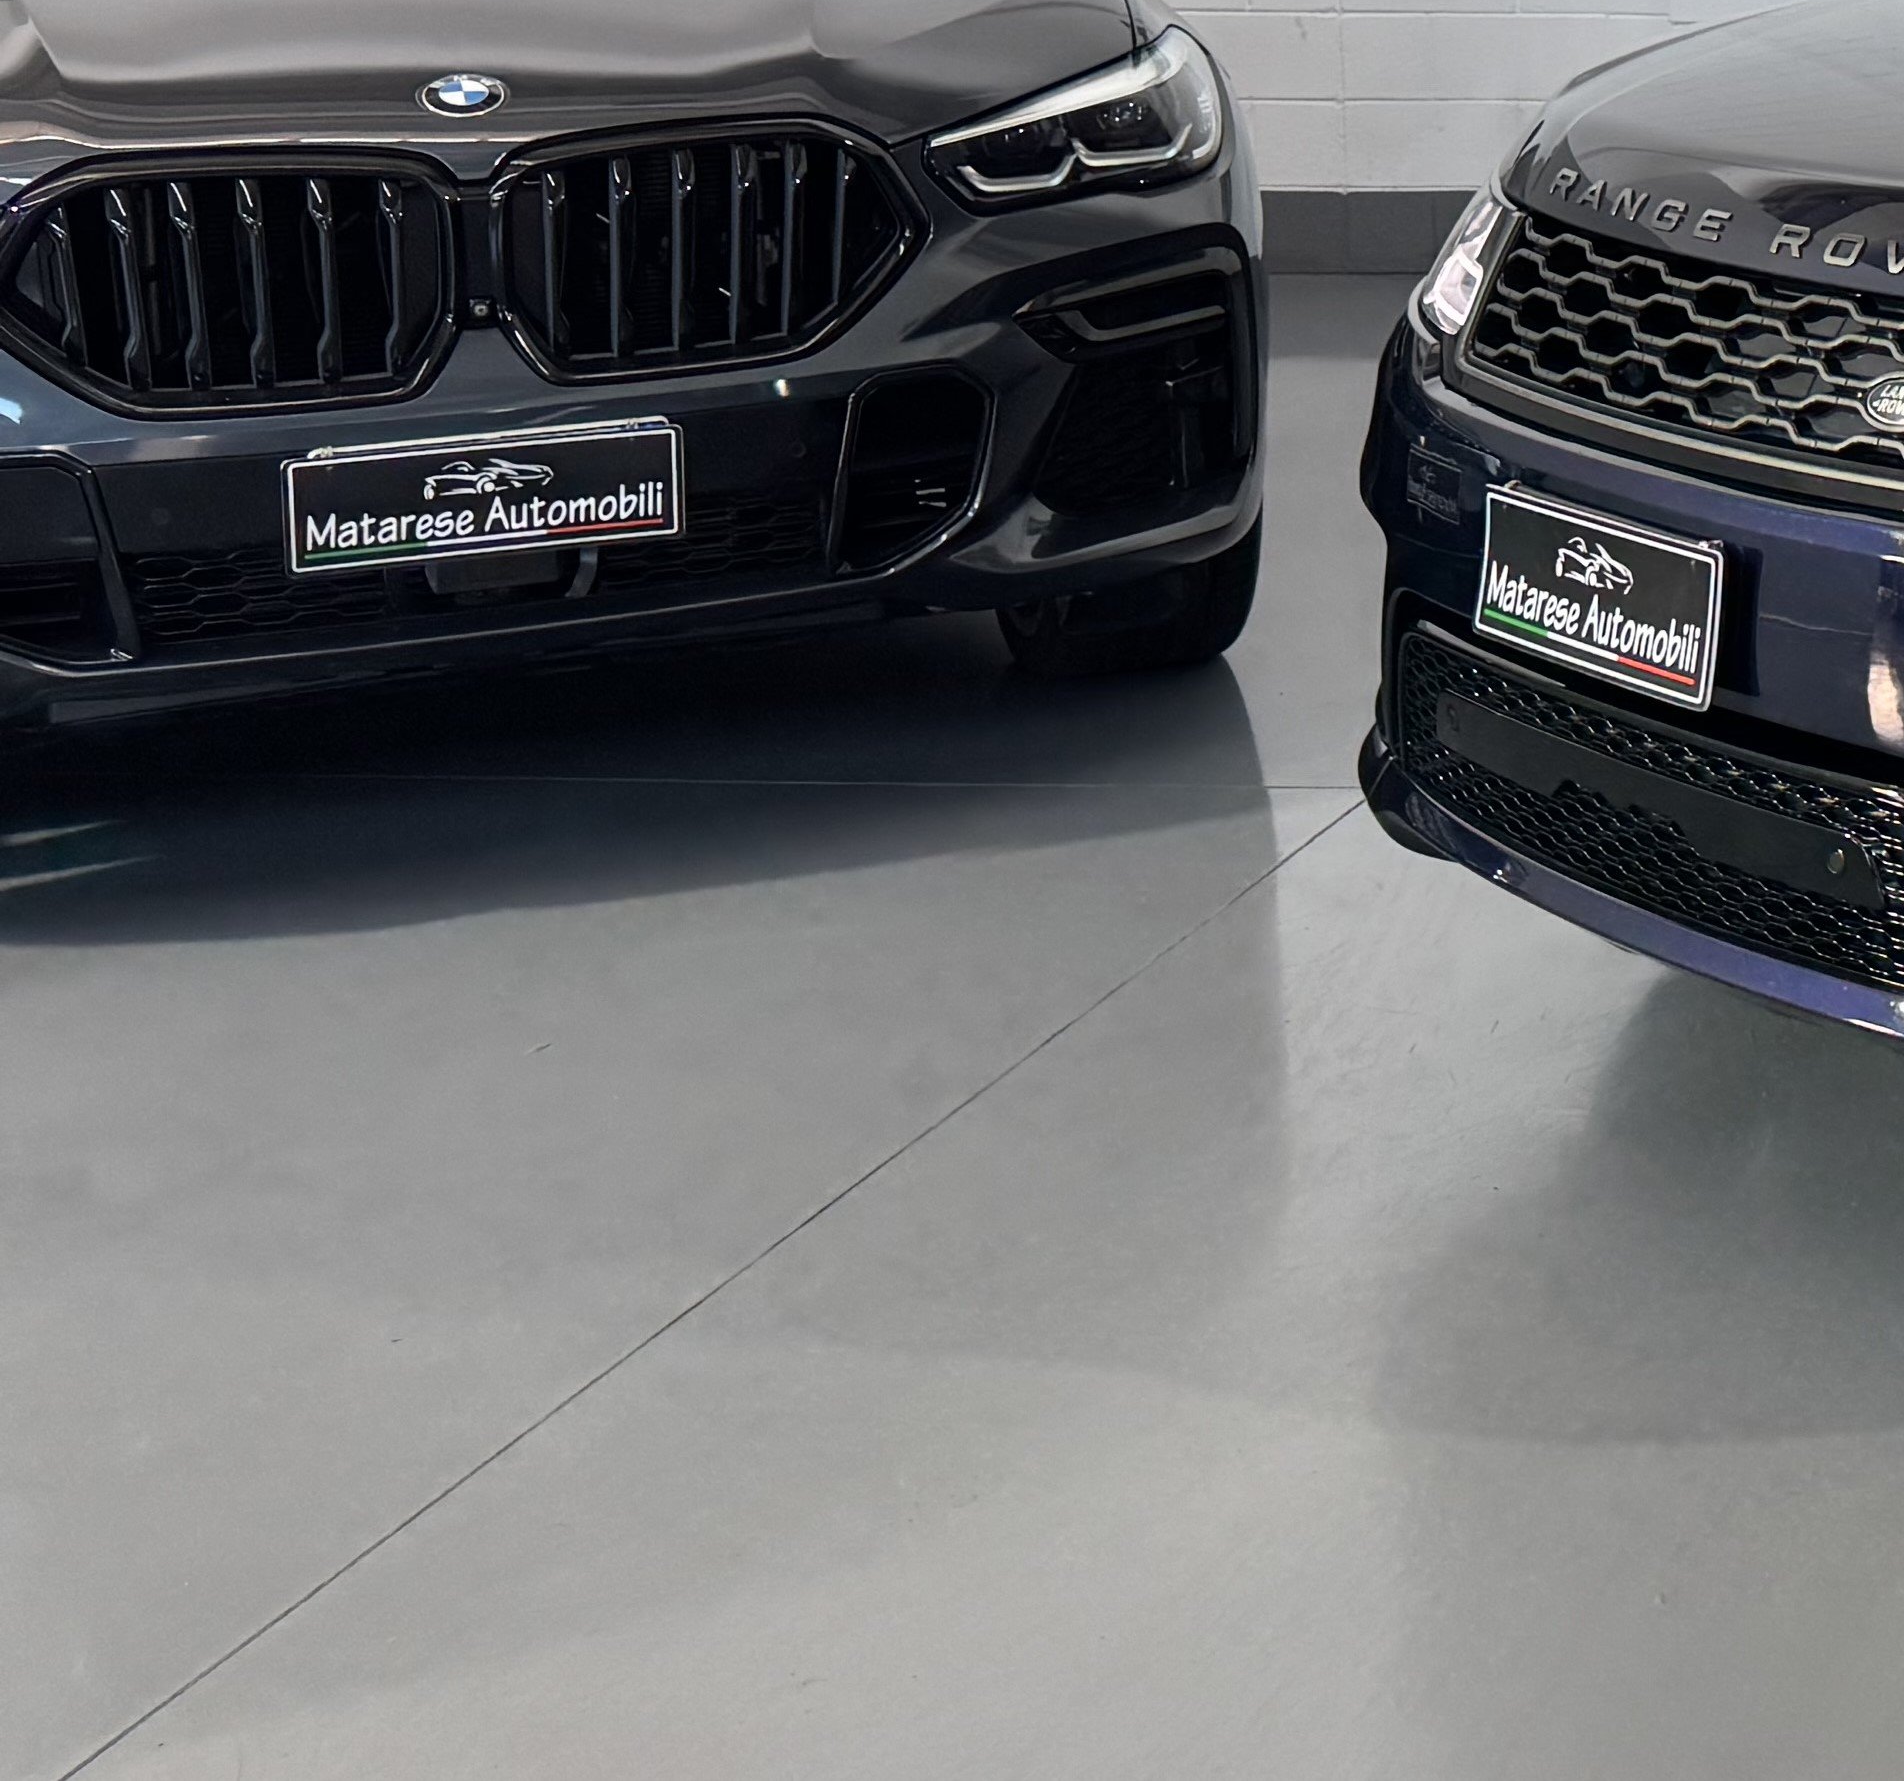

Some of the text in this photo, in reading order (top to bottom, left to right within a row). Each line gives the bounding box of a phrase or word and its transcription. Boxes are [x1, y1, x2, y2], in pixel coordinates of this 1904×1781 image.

[1548, 166, 1733, 242] RANGE
[306, 481, 664, 552] Matarese Automobili
[1486, 559, 1702, 675] Matarese Automobili
